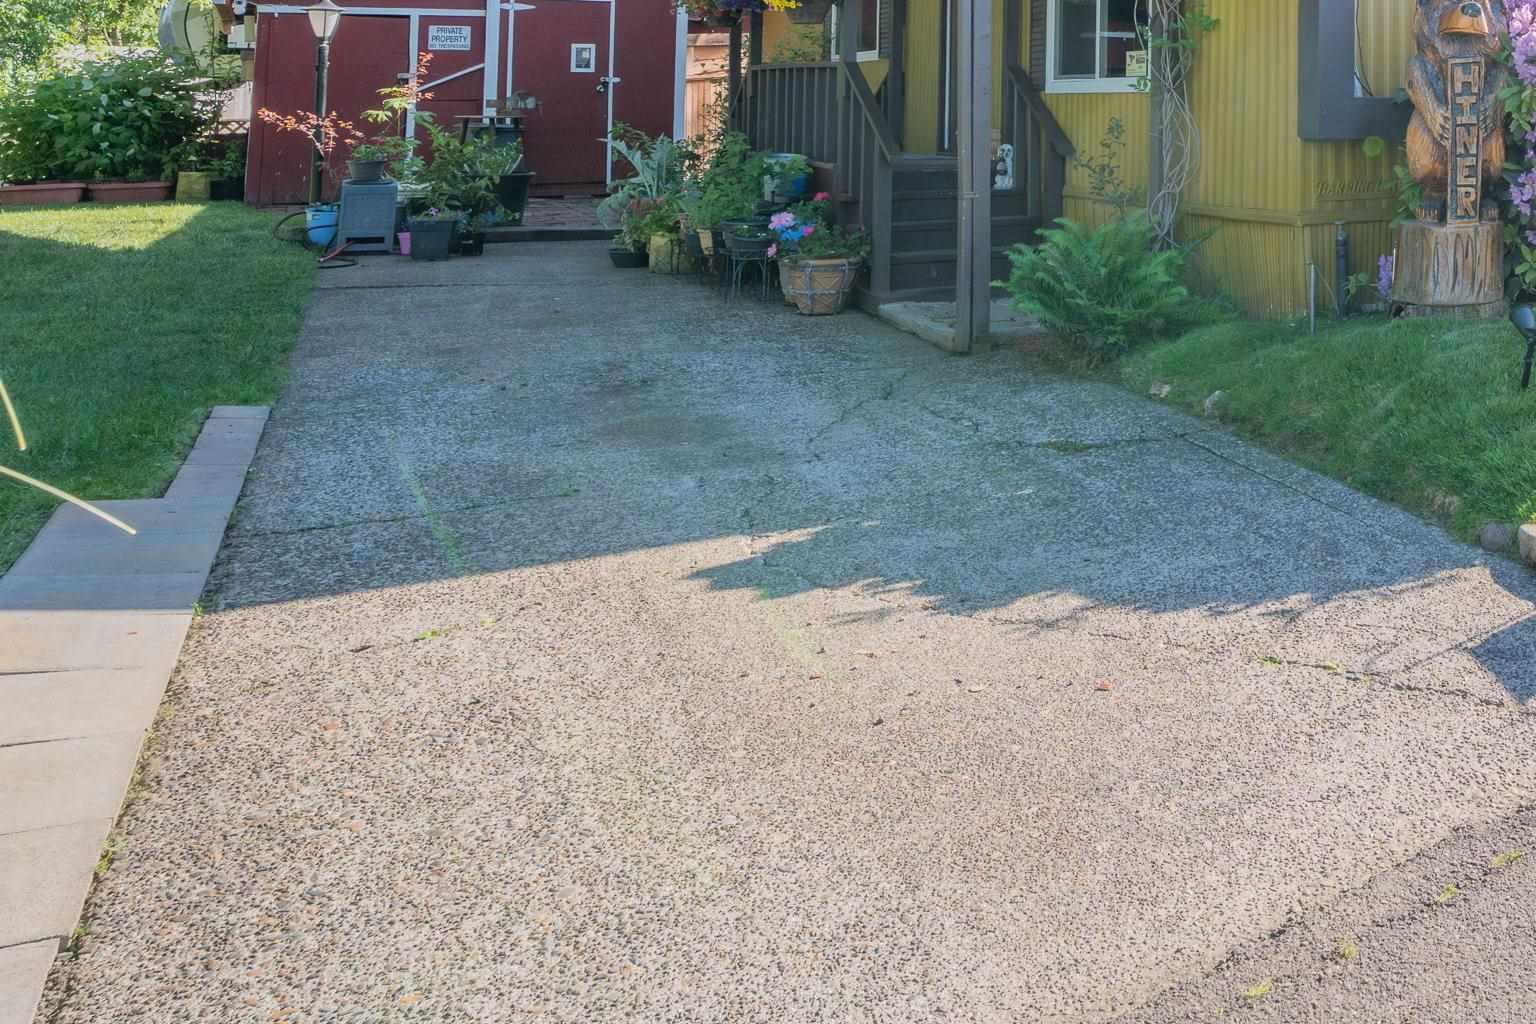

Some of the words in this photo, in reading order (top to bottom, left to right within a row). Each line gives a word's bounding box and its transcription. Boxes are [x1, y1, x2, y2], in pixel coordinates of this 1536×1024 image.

[436, 27, 464, 35] PRIVATE
[431, 35, 467, 43] PROPERTY
[1454, 62, 1480, 217] HINER
